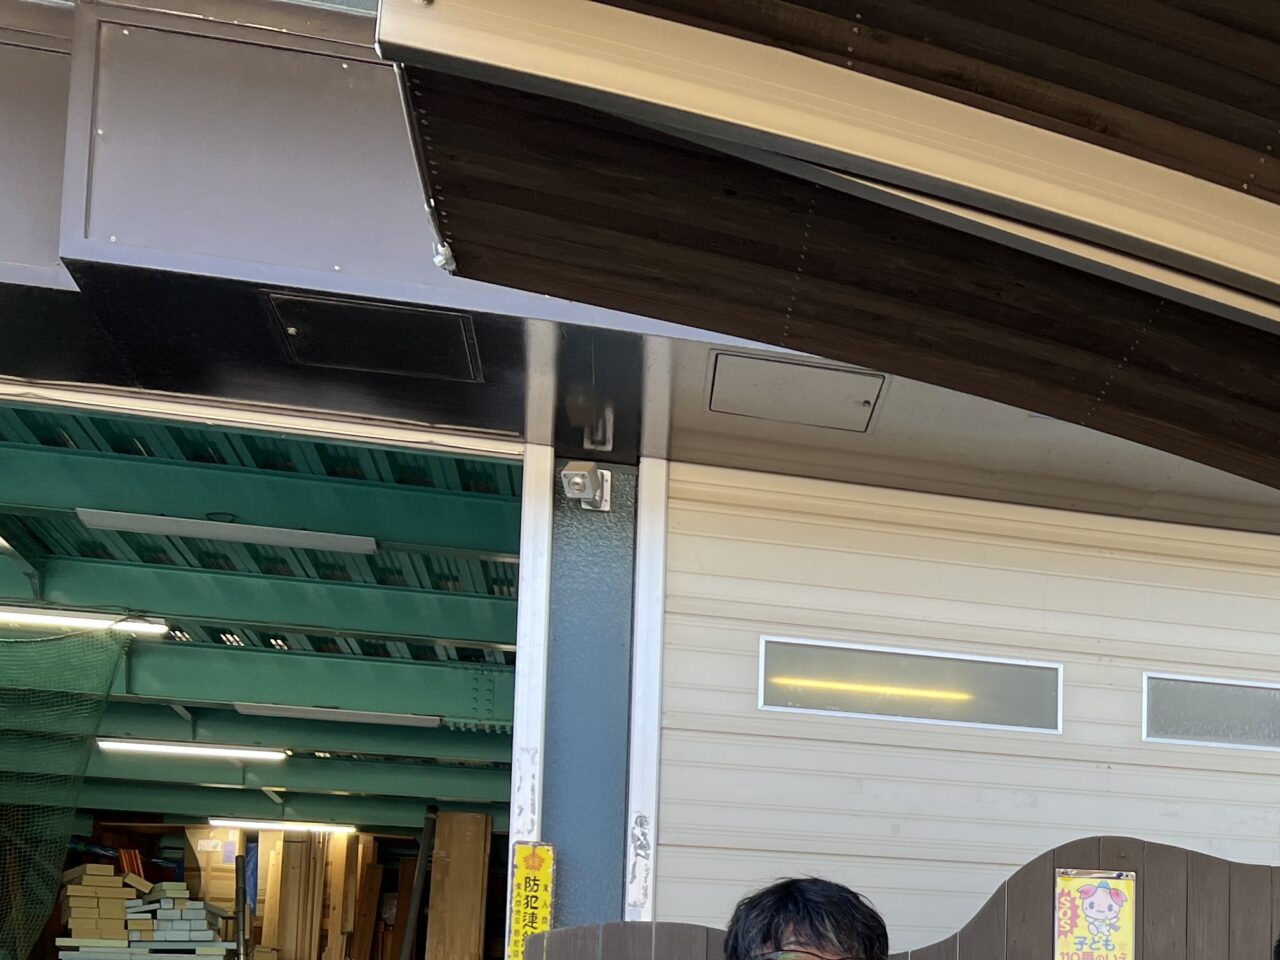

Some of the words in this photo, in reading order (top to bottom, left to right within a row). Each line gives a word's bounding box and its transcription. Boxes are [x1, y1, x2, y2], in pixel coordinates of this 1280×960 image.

[1059, 896, 1072, 932] SOS
[1073, 936, 1115, 951] 子ども
